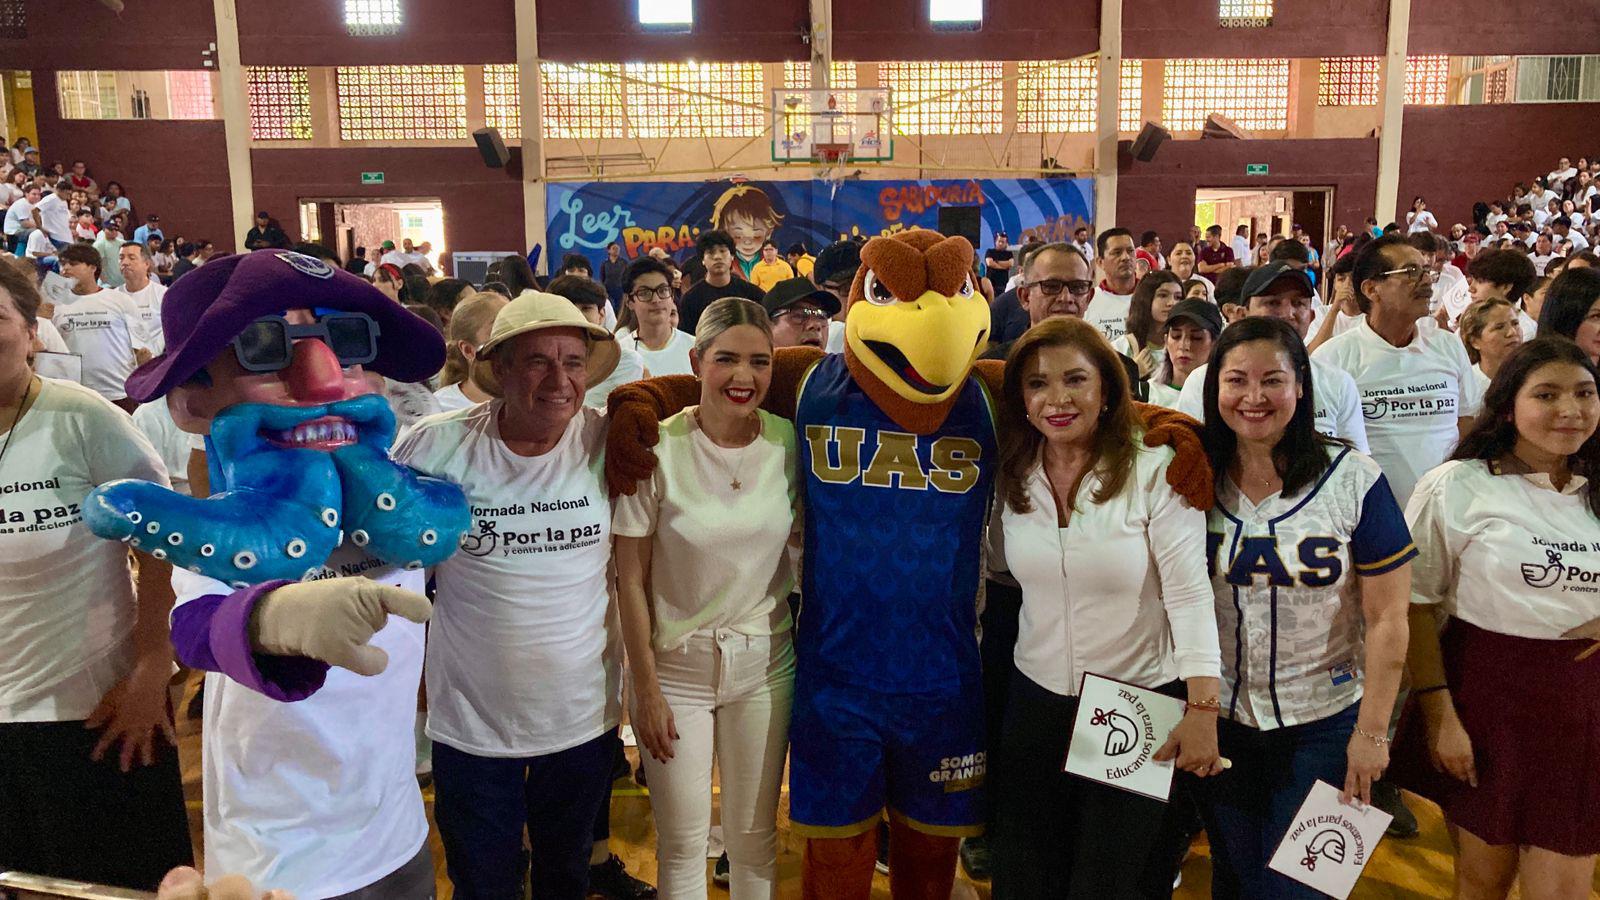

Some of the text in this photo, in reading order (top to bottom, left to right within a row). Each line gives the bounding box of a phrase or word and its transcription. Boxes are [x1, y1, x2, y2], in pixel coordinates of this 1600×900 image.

[560, 191, 636, 249] Leer
[1362, 381, 1448, 398] Jornada Nacional
[1391, 399, 1455, 412] Por la paz
[805, 425, 983, 494] UAS
[0, 503, 81, 525] la paz
[531, 496, 590, 514] Nacional
[503, 523, 602, 546] Por la paz
[503, 549, 509, 557] y
[511, 546, 543, 555] contra
[560, 538, 601, 551] adicciones
[1106, 689, 1157, 779] Educamos para la paz
[1290, 814, 1364, 866] Educamos para la paz
